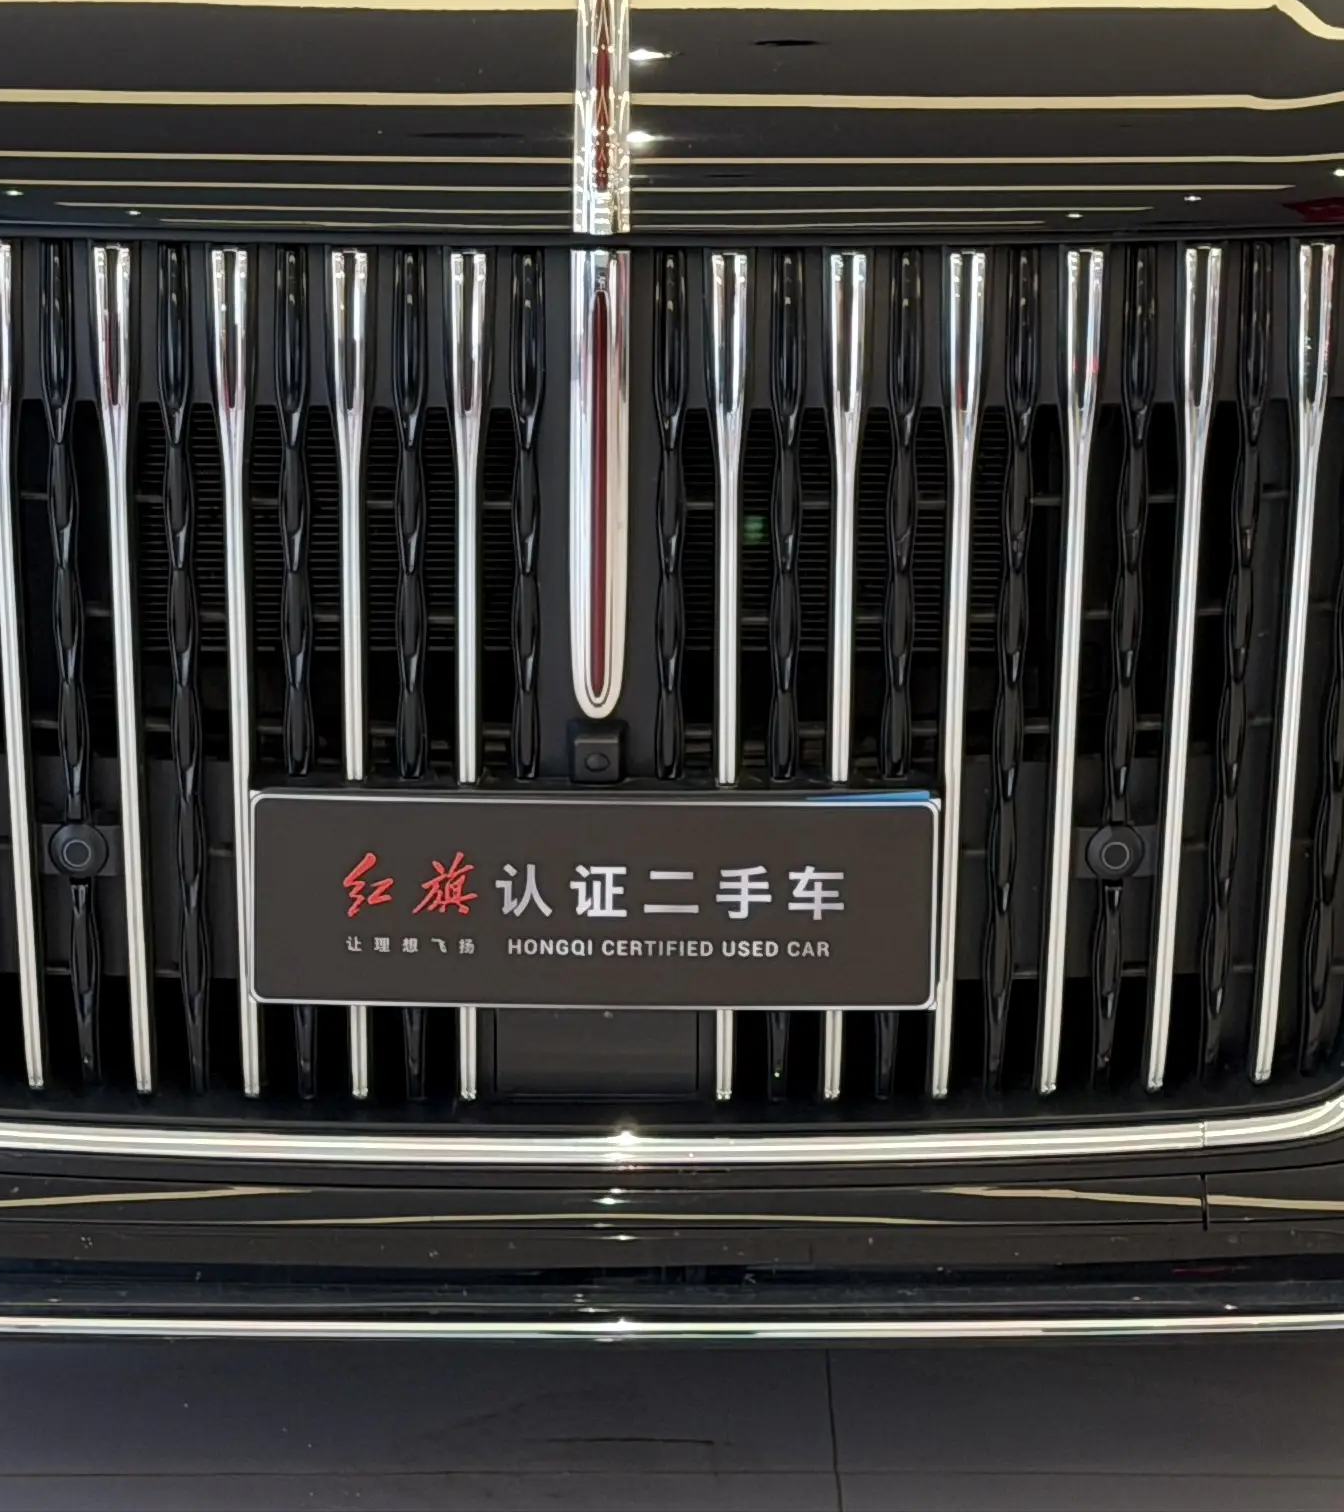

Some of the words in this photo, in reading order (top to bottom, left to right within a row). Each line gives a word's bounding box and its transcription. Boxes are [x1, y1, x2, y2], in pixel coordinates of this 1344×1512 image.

[345, 934, 476, 956] 让理想飞扬
[506, 937, 594, 959] HONGQI
[600, 938, 715, 959] CERTIFIED
[720, 939, 780, 959] USED
[786, 940, 831, 959] CAR
